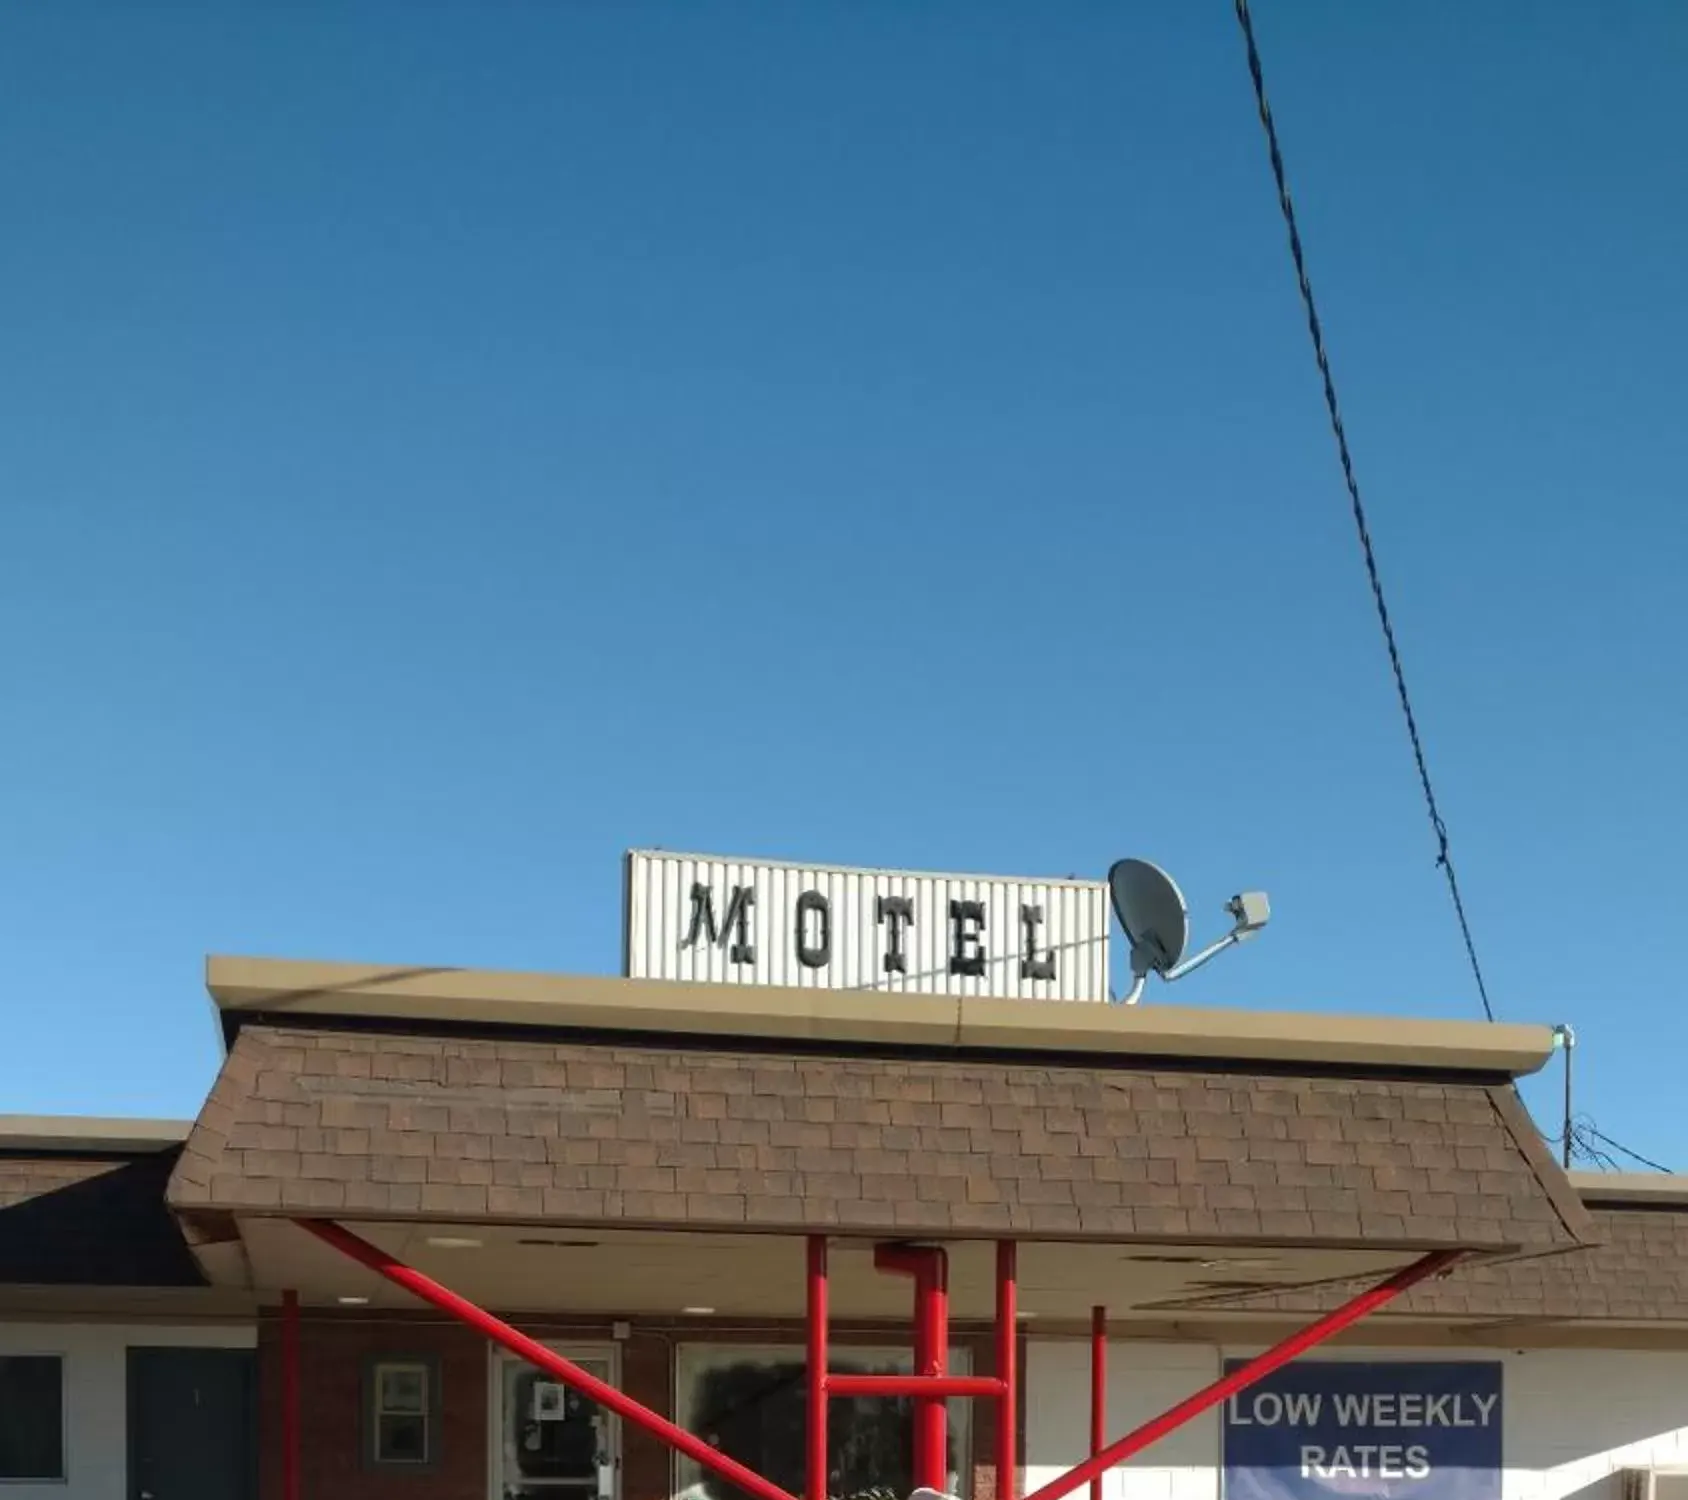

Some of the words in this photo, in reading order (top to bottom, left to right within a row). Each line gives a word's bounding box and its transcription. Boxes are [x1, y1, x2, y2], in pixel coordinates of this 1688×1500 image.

[681, 881, 1057, 981] MOTEL
[1229, 1392, 1322, 1427] LOW
[1333, 1393, 1498, 1427] WEEKLY
[1299, 1445, 1431, 1479] RATES
